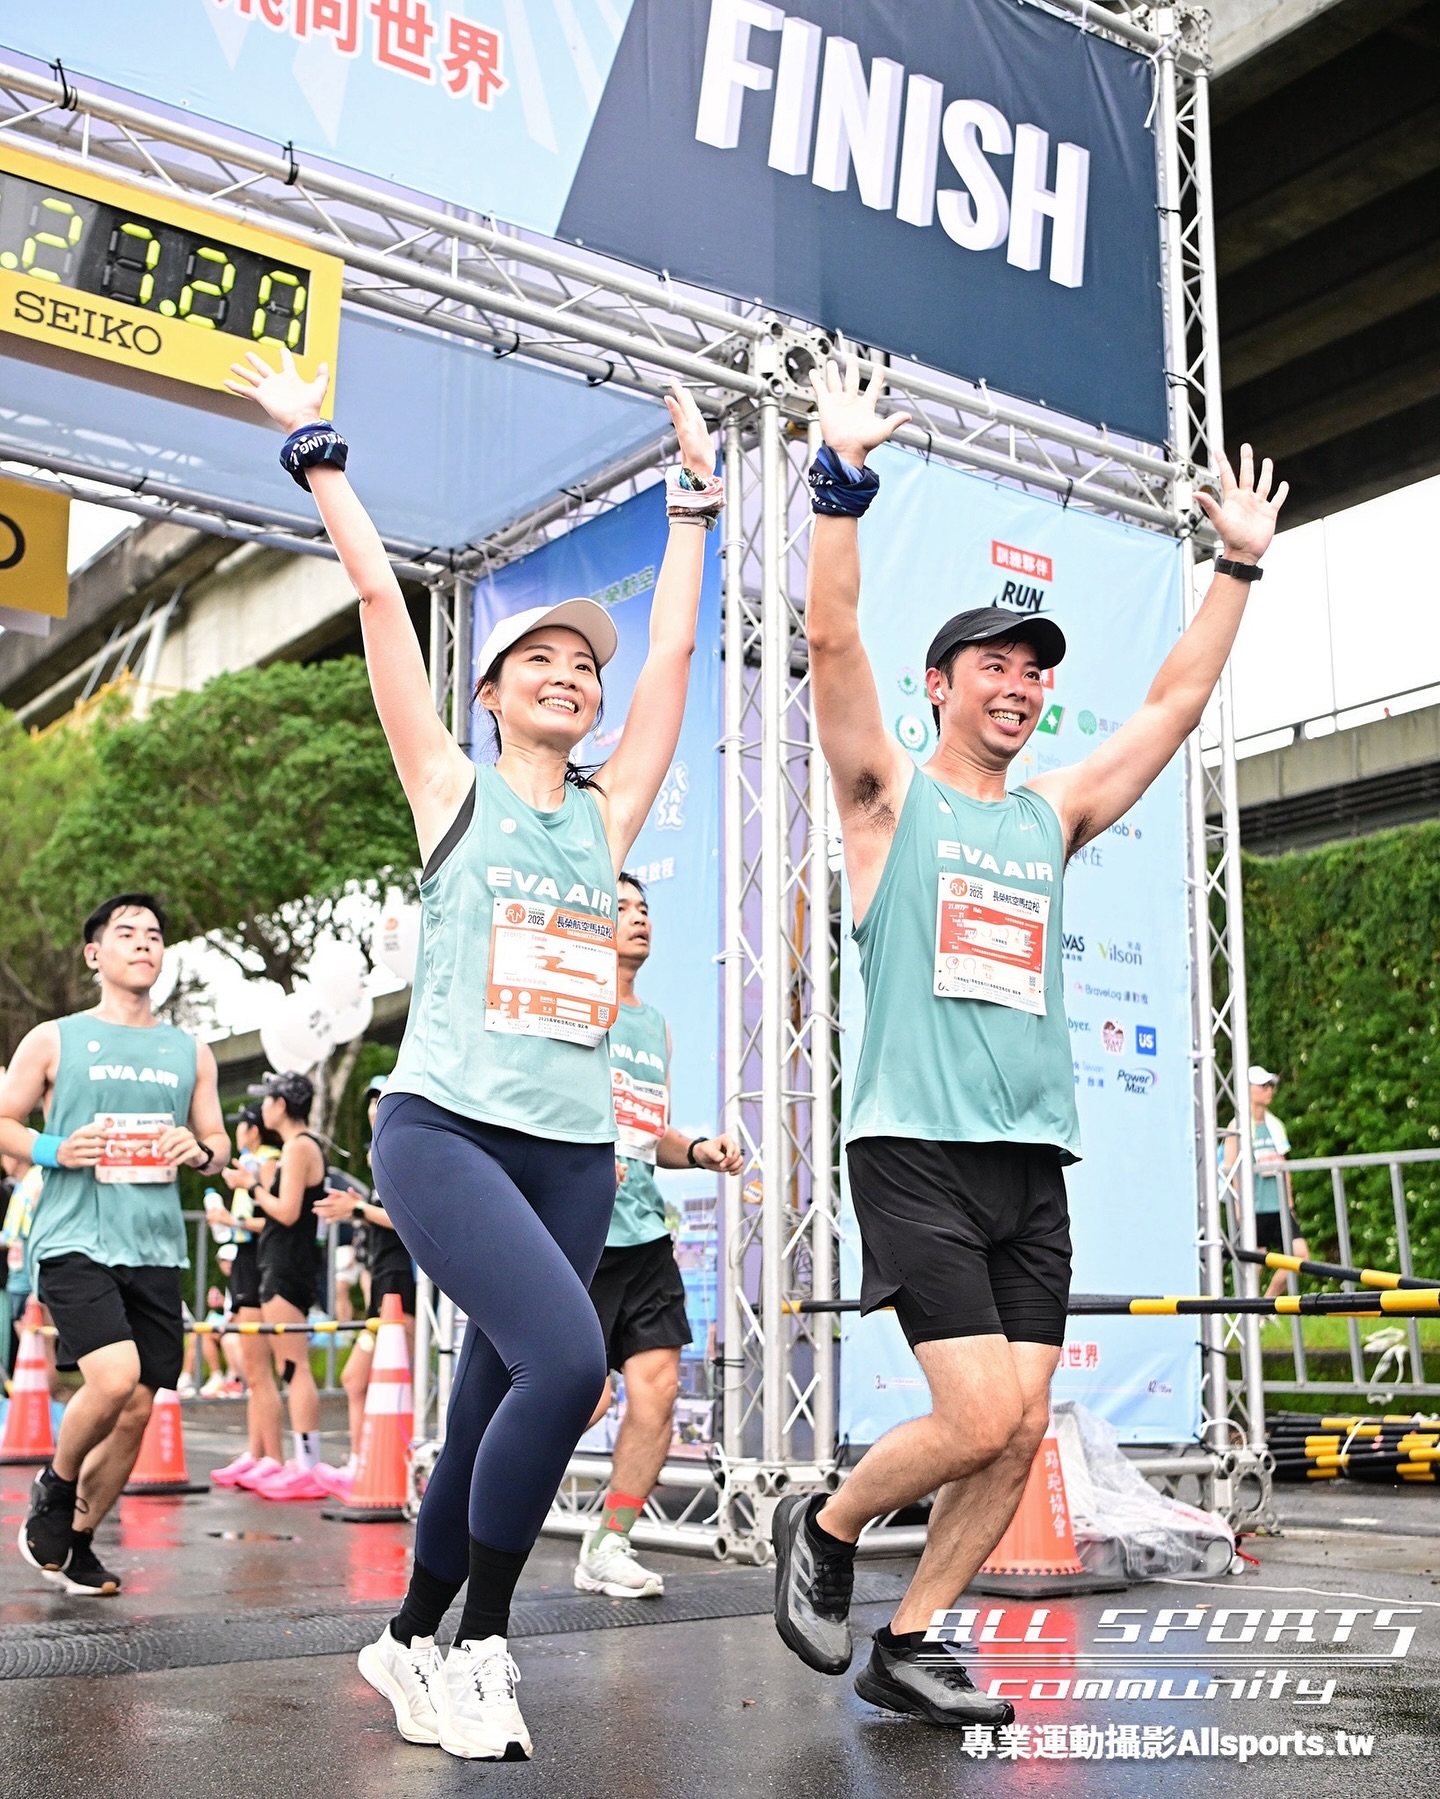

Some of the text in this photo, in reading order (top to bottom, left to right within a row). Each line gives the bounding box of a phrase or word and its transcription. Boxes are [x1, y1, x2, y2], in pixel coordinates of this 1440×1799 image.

[695, 0, 1090, 288] FINISH
[14, 289, 163, 355] SEIKO
[299, 432, 347, 455] YCLING
[1001, 580, 1044, 612] RUN
[938, 840, 1054, 882] EVA AIR
[487, 865, 613, 915] EVA AIR
[528, 914, 545, 926] 2025
[1098, 939, 1142, 966] Vilson
[1138, 1033, 1154, 1049] US
[1117, 1069, 1150, 1085] Power
